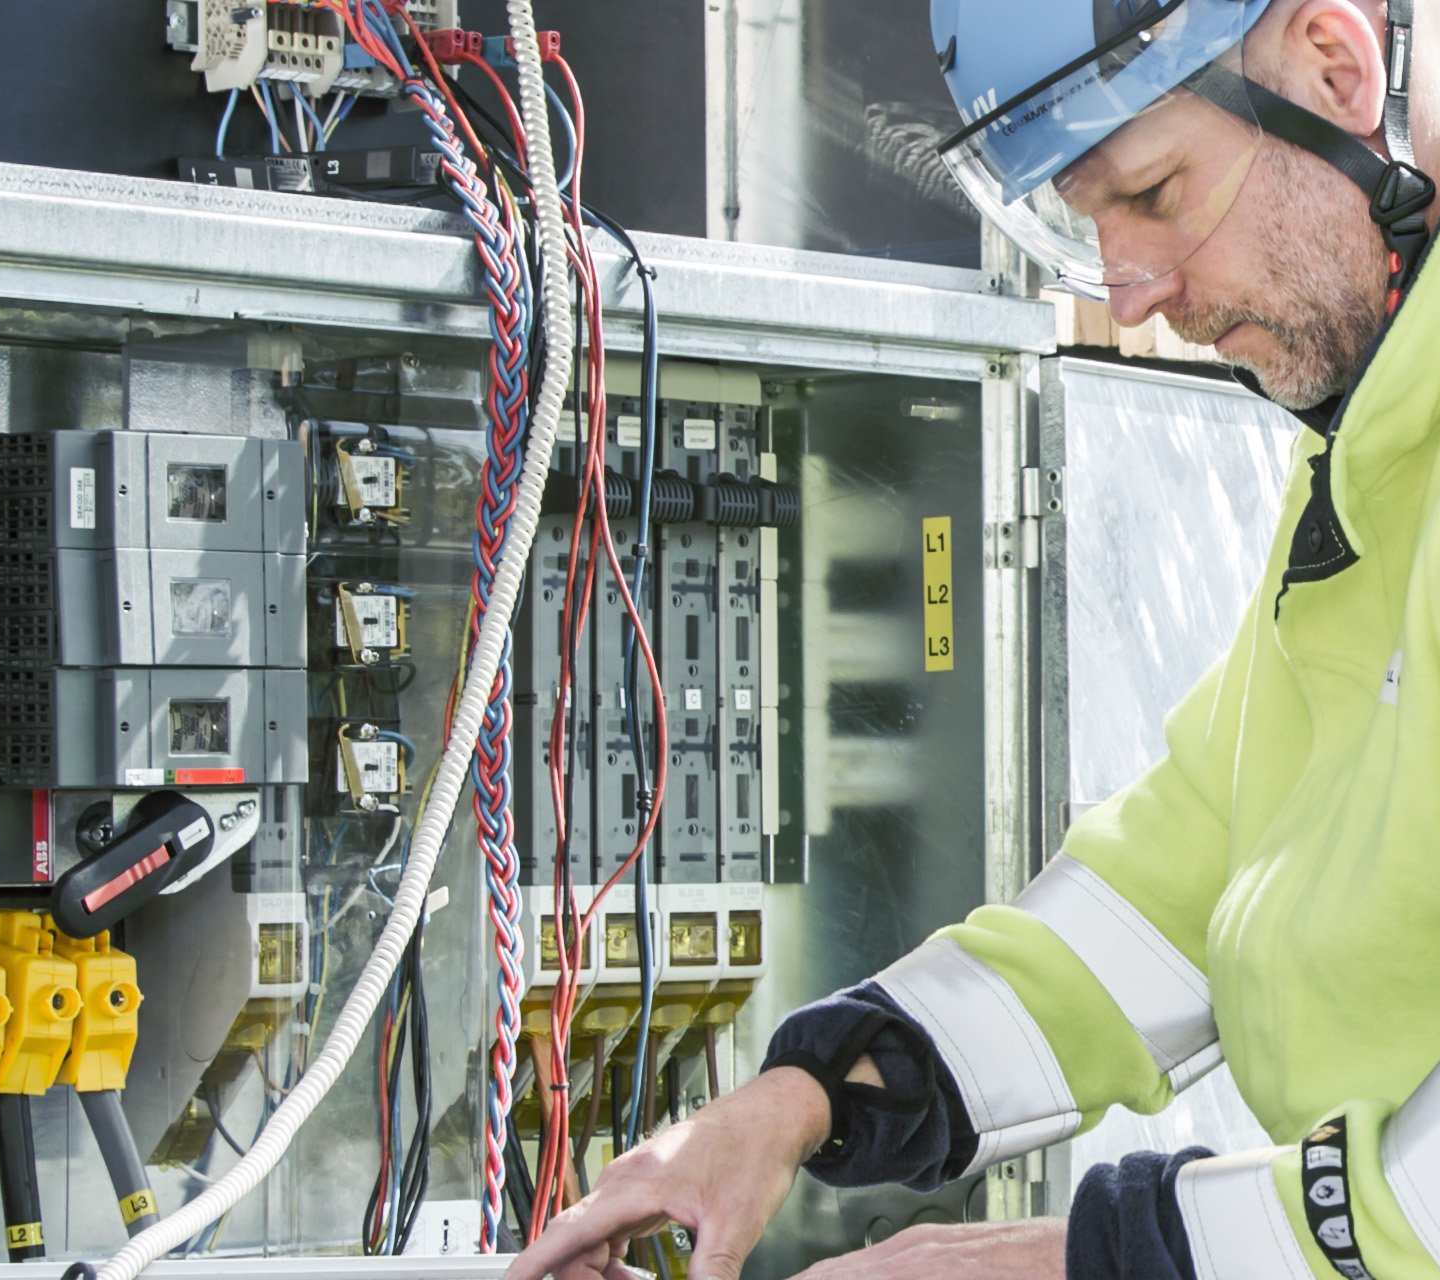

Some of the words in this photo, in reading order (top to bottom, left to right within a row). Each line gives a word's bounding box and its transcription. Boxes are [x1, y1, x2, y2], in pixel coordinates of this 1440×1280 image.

[327, 160, 339, 175] L3
[926, 532, 945, 552] L1
[927, 584, 949, 604] L2
[928, 636, 950, 656] L3
[690, 693, 698, 705] C
[740, 693, 747, 704] D
[36, 840, 48, 875] ABB
[130, 1196, 148, 1213] L3
[10, 1227, 27, 1243] L2
